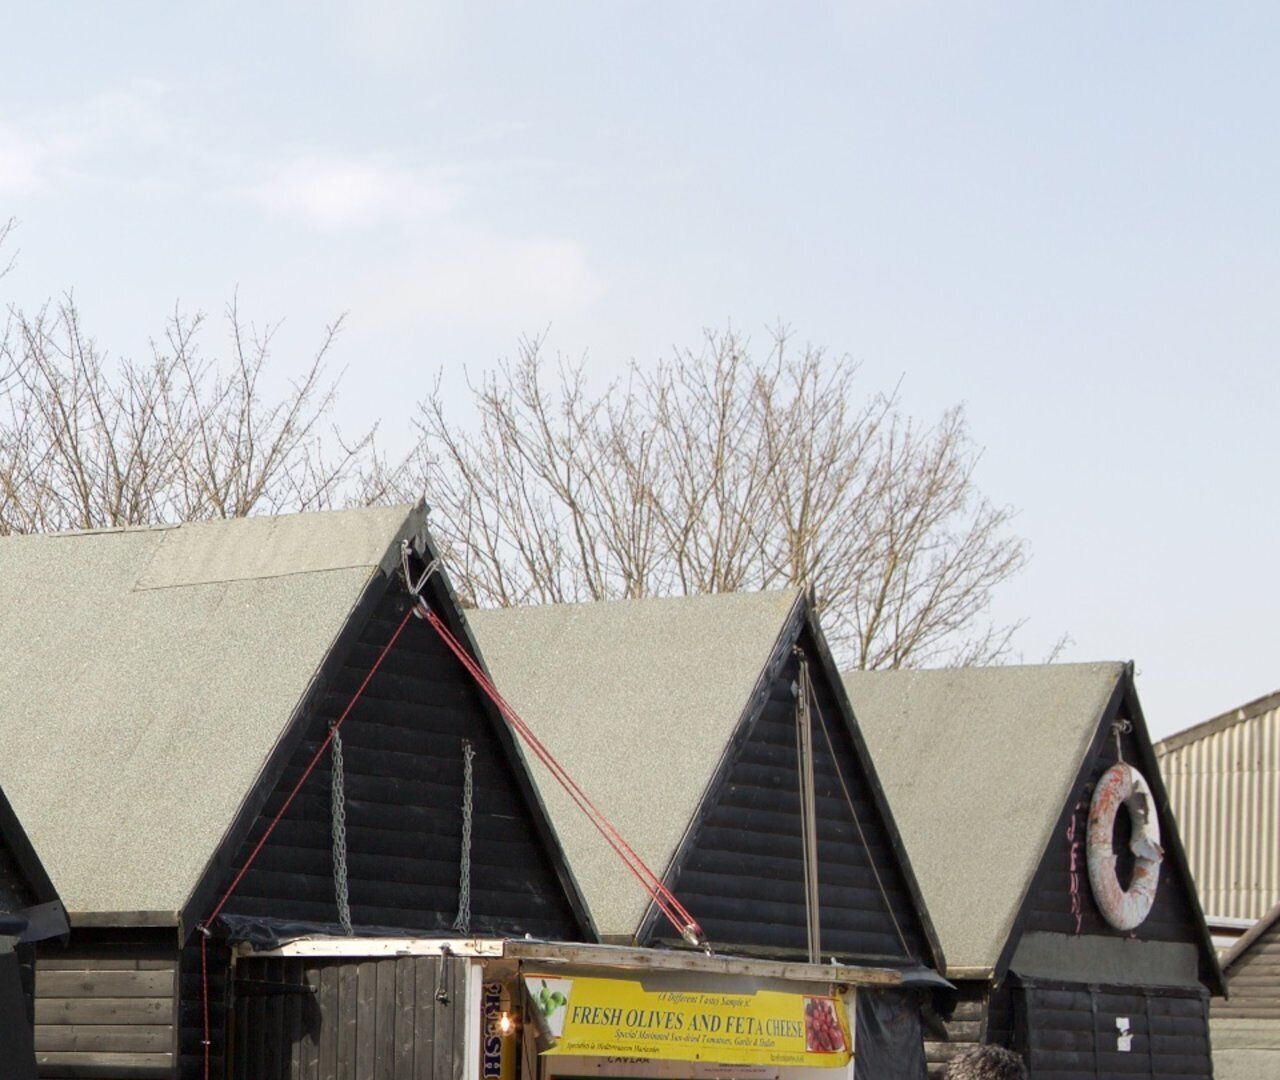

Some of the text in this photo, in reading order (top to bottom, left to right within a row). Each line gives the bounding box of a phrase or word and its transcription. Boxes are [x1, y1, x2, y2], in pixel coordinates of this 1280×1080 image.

[571, 1006, 623, 1027] FRESH
[626, 1008, 684, 1030] OLIVES
[690, 1011, 722, 1033] AND
[765, 1018, 804, 1039] CHEESE
